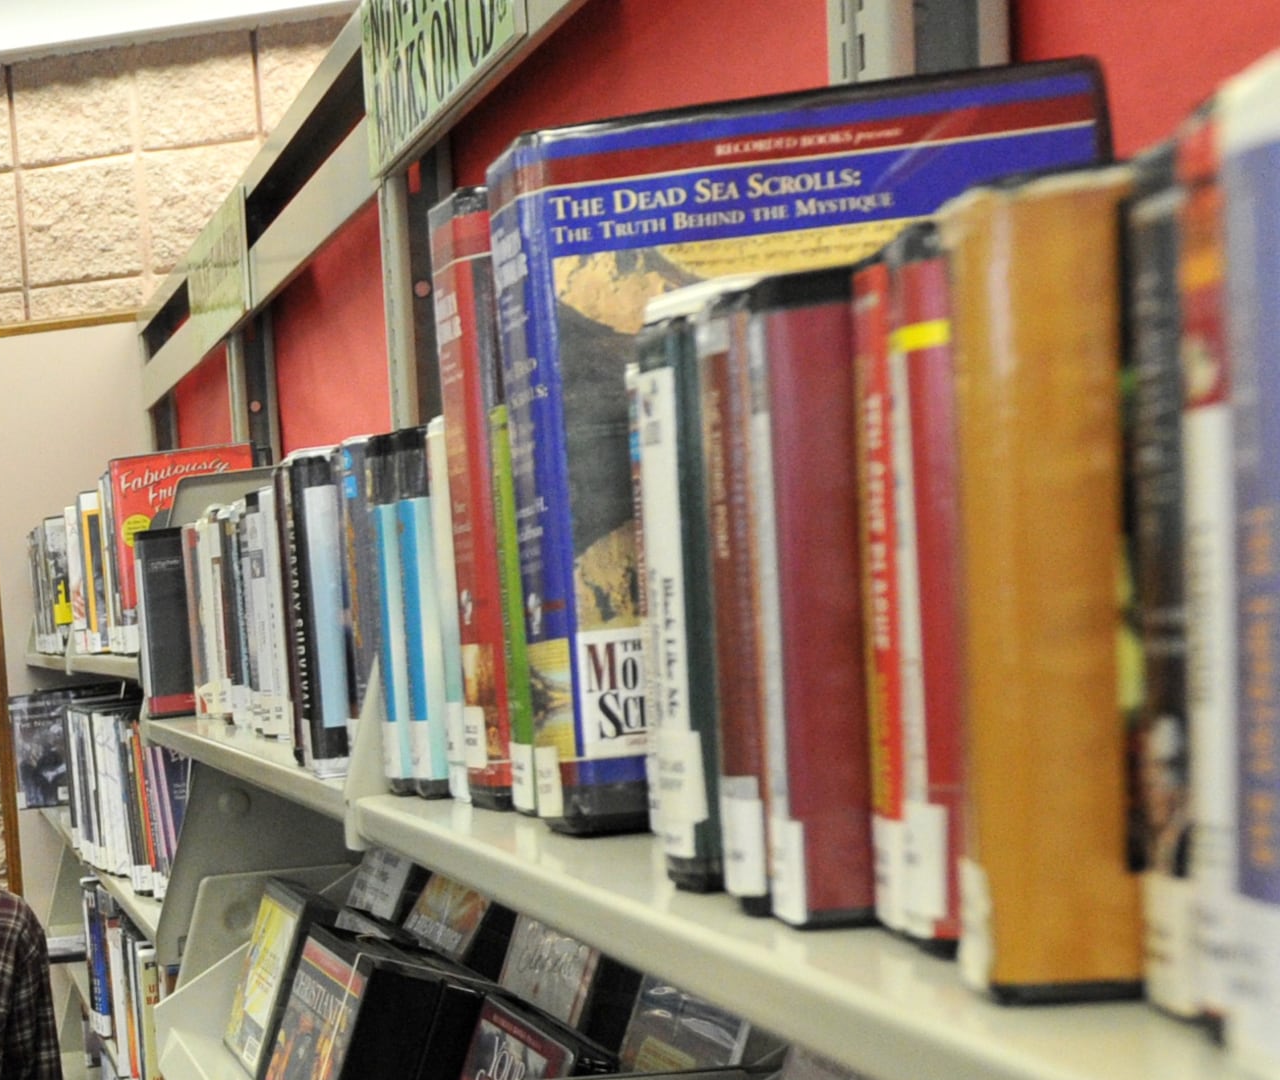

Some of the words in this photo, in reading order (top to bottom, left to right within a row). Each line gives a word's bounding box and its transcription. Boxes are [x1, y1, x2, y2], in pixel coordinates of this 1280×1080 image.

[550, 195, 605, 221] THE
[612, 184, 687, 215] DEAD
[694, 178, 740, 207] SEA
[746, 166, 863, 199] SCROLLS:
[550, 223, 593, 245] THE
[600, 214, 668, 240] TRUTH
[673, 207, 746, 231] BEHIND
[752, 203, 789, 224] THE
[794, 191, 896, 220] MYSTIQUE
[120, 458, 231, 495] Fabulously
[285, 519, 303, 611] EVERYDAY
[658, 577, 676, 631] Black
[865, 542, 893, 652] PLAGUE
[662, 637, 679, 680] Like
[664, 686, 681, 718] Me
